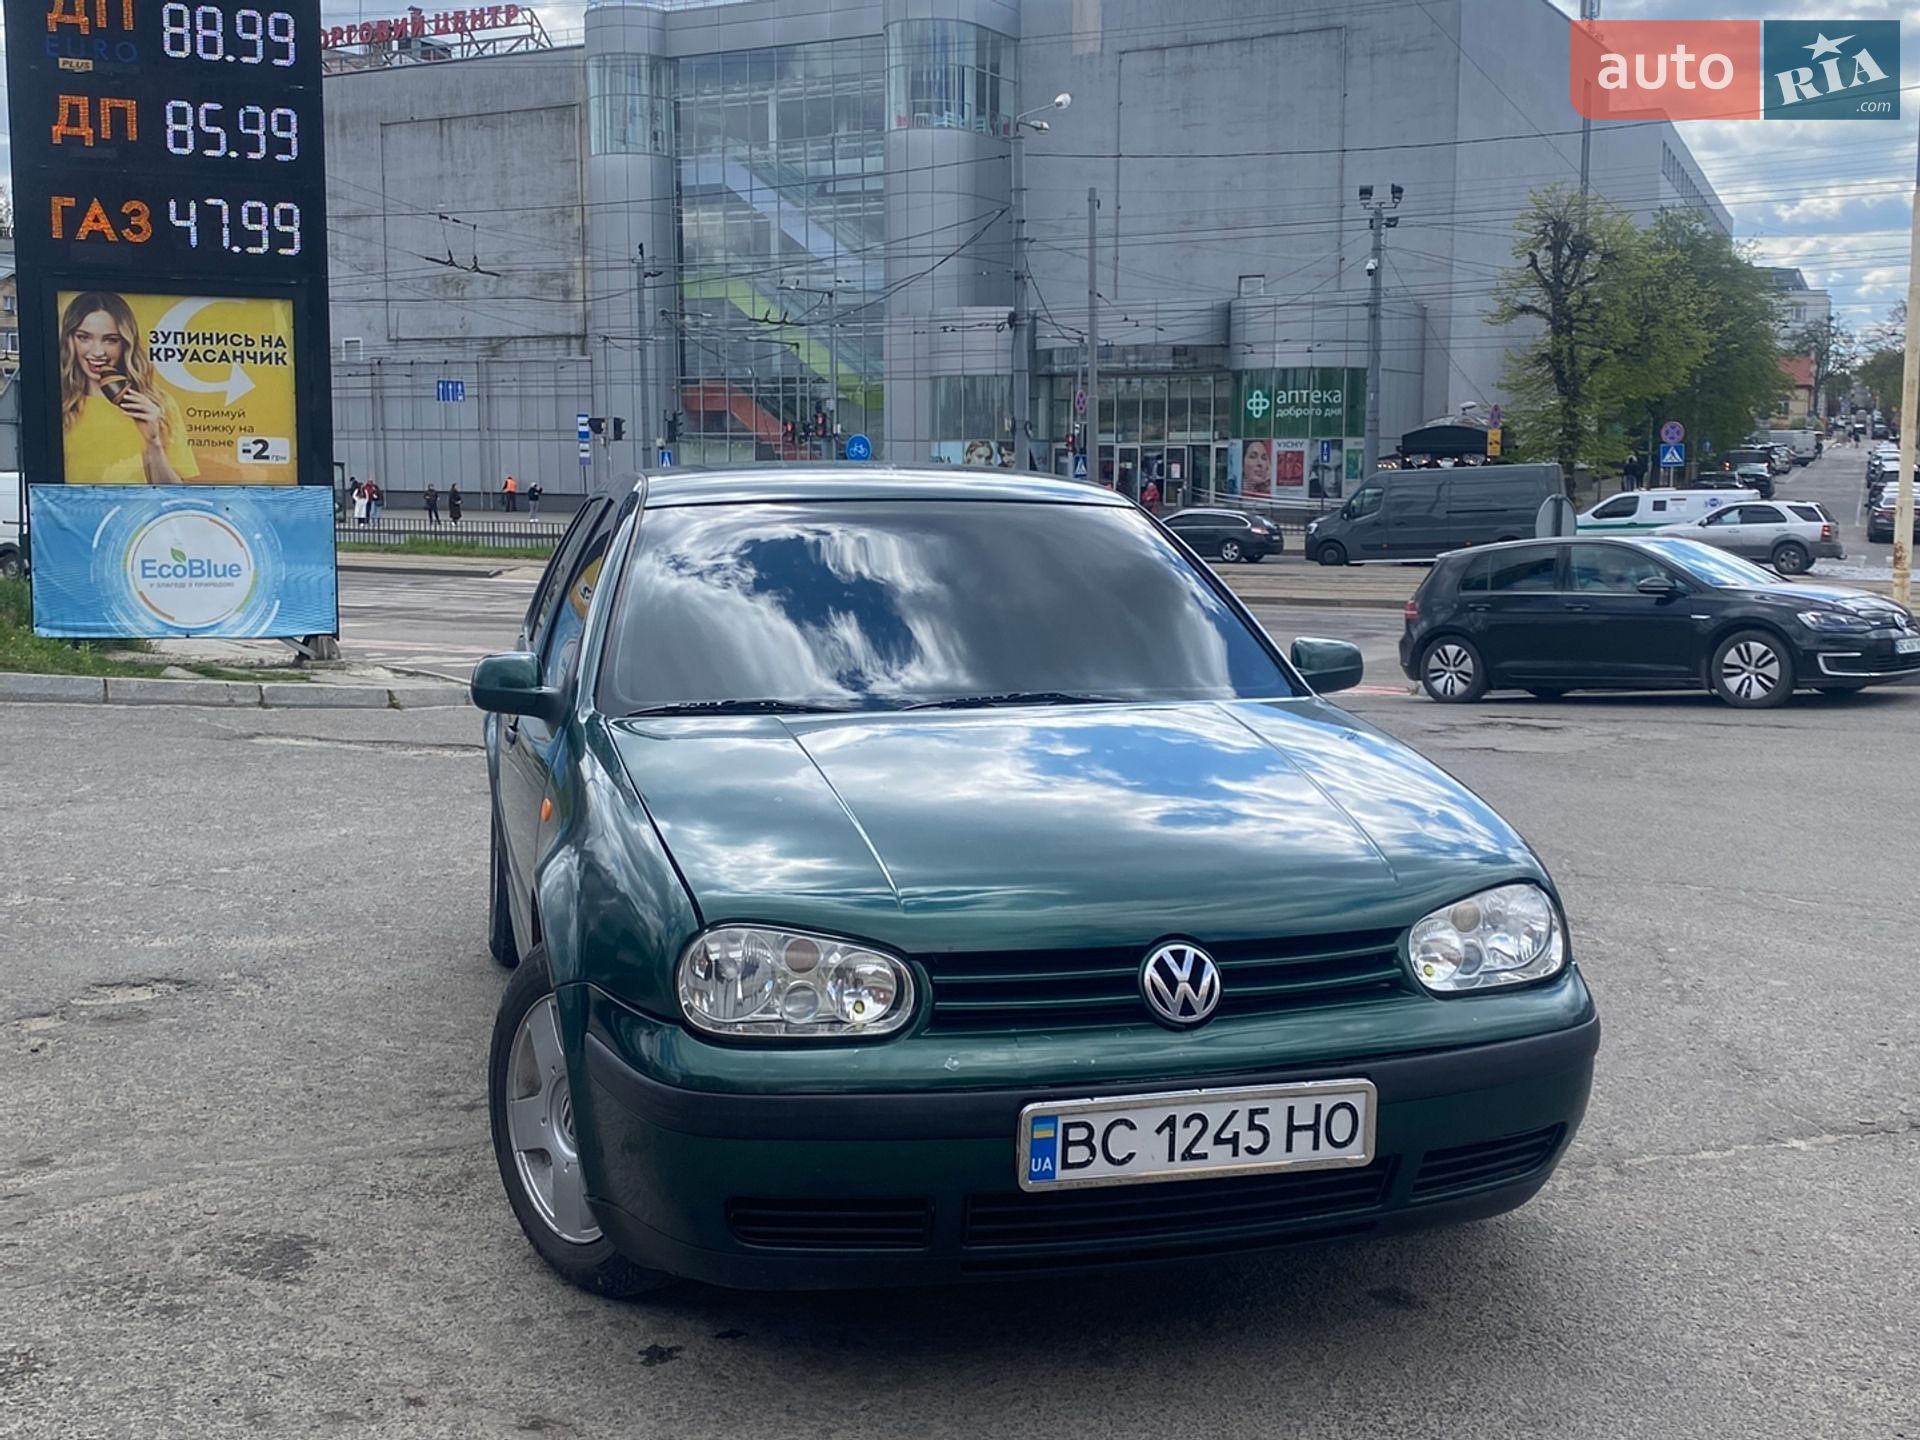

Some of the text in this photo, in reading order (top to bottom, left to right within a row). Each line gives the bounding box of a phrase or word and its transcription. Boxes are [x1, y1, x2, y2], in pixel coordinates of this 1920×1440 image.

[47, 0, 134, 35] ДП
[434, 4, 520, 35] ЦЕНТР
[161, 2, 296, 67] 88.99
[45, 34, 138, 62] EURO
[61, 60, 91, 69] PLUS
[52, 95, 138, 147] ДП
[165, 100, 298, 162] 85.99
[51, 196, 153, 243] ГАЗ
[168, 199, 301, 256] 47.99
[149, 330, 287, 348] ЗУПИНИСЬ НА
[150, 347, 287, 365] КРУАСАНЧИК
[1276, 389, 1342, 404] аптека
[186, 407, 246, 420] Отримуй
[1276, 407, 1342, 418] доброго дня
[186, 424, 236, 434] знижку
[187, 438, 234, 448] пальне
[242, 438, 270, 460] -2
[141, 558, 242, 579] EcoBlue
[1031, 1100, 1360, 1173] UA BC 1245 HO
